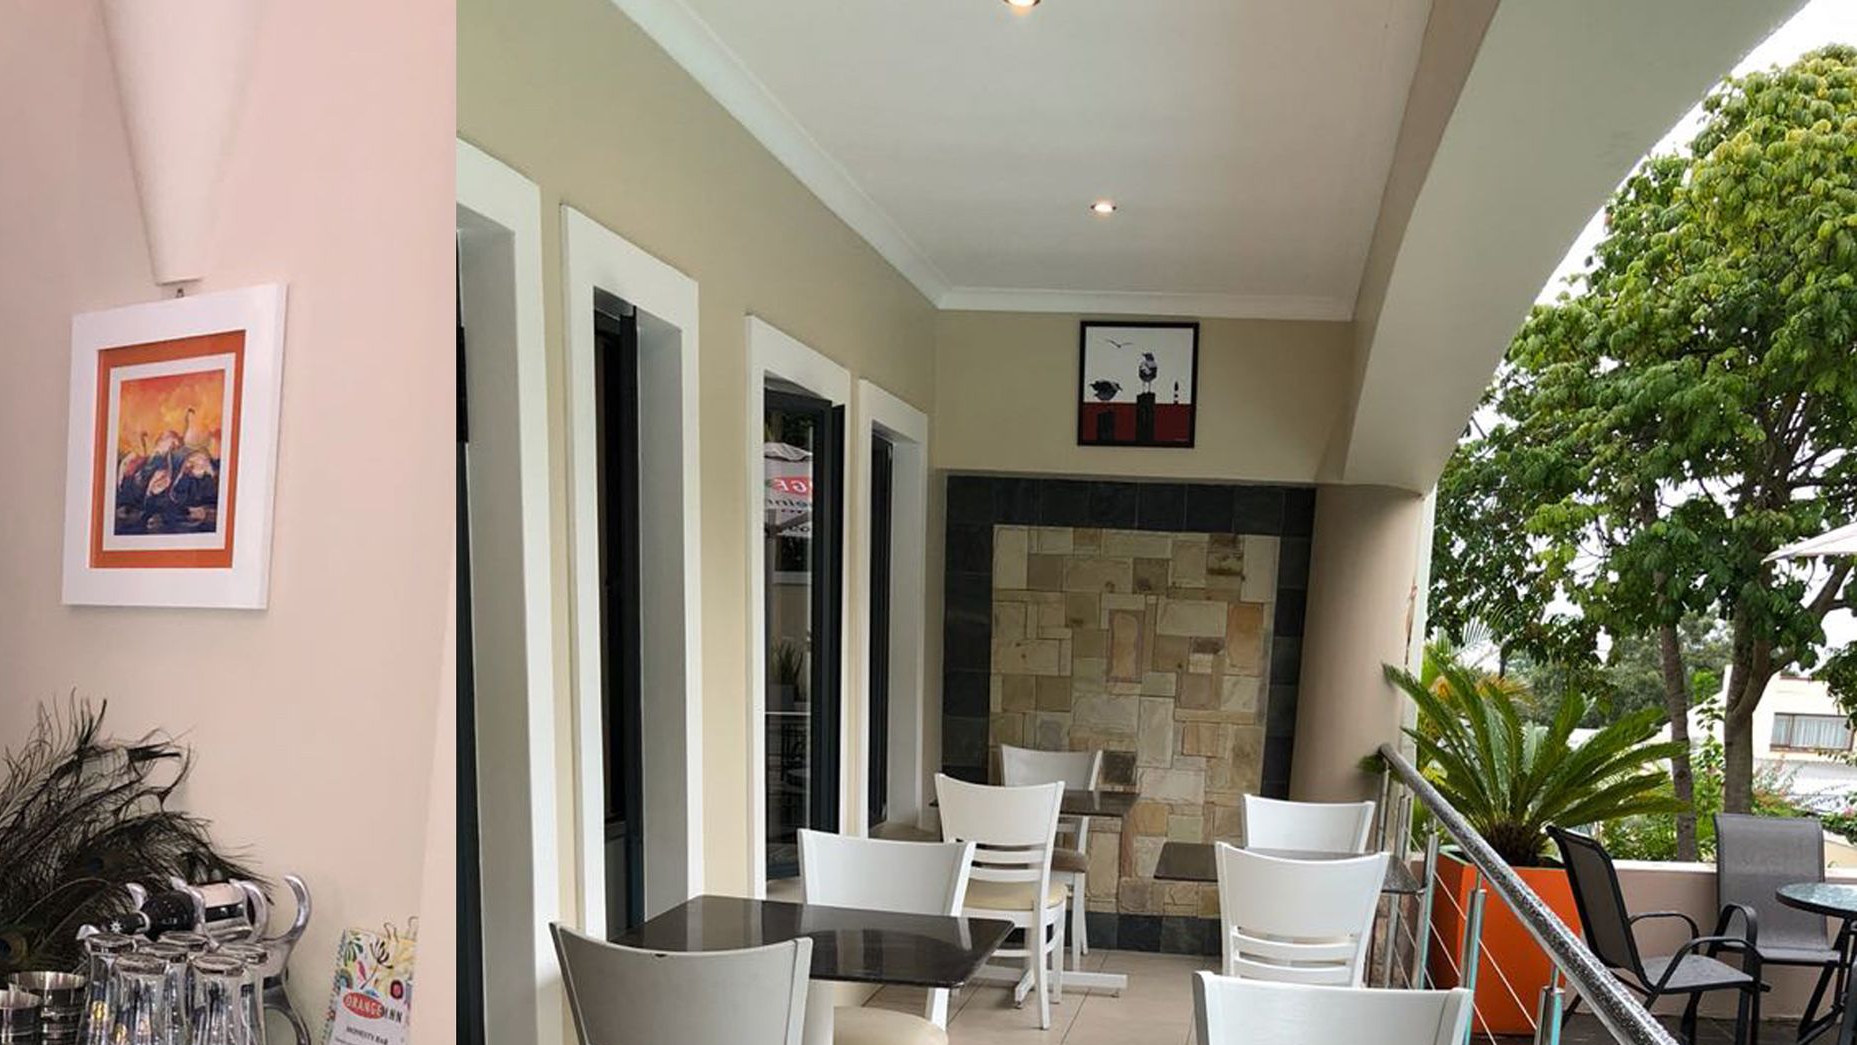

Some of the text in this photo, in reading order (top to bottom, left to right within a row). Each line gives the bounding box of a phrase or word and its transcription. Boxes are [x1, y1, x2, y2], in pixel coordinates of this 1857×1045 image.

[345, 995, 403, 1023] ORANGE INN
[375, 1034, 389, 1045] BAR
